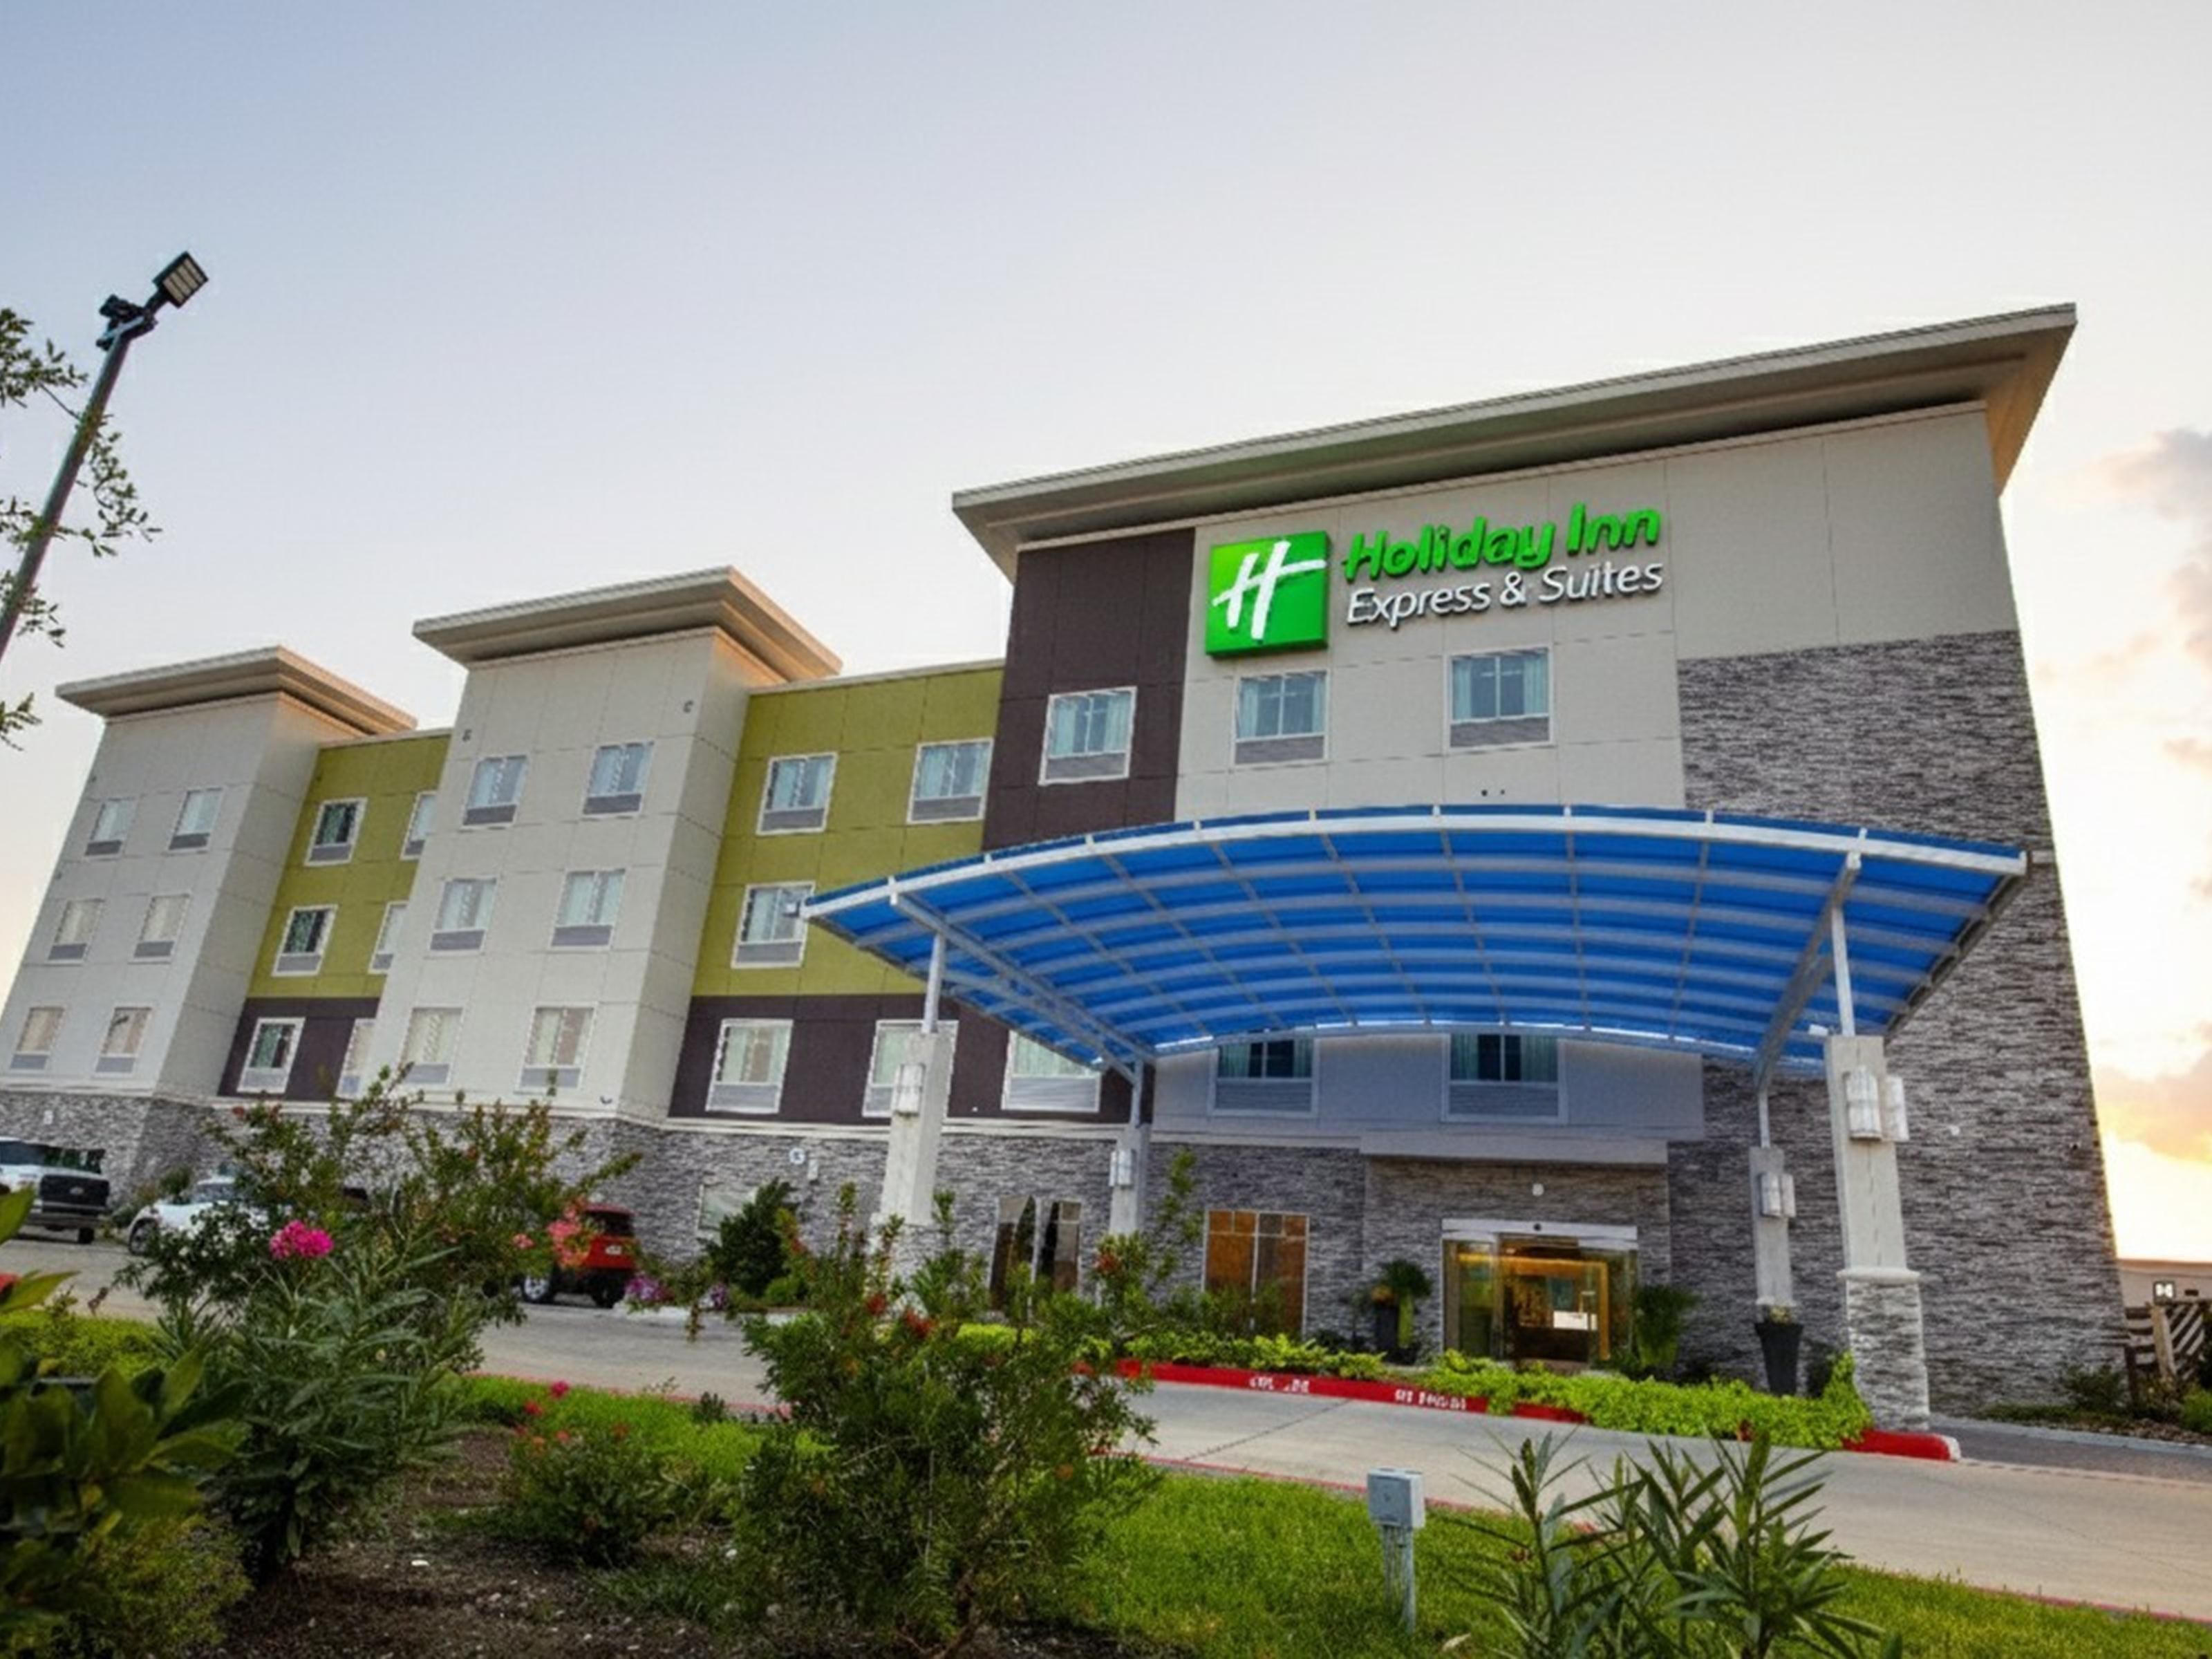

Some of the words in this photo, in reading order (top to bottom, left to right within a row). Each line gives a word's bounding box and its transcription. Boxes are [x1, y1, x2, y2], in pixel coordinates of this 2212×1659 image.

[1342, 516, 1555, 581] Holiday
[1565, 502, 1660, 555] Inn
[1347, 582, 1491, 630] Express
[1499, 570, 1527, 608] &
[1538, 561, 1664, 603] Suites
